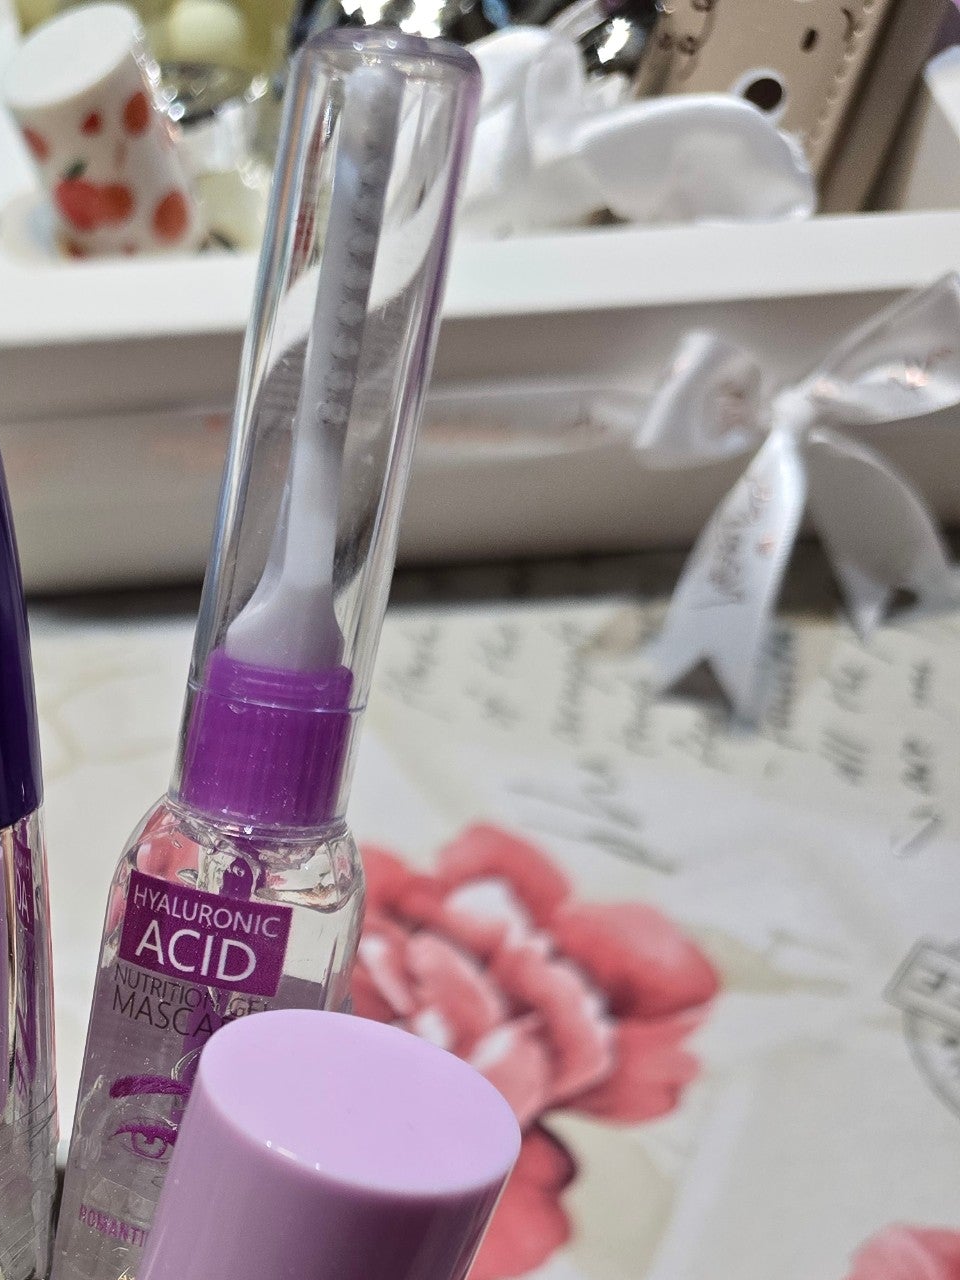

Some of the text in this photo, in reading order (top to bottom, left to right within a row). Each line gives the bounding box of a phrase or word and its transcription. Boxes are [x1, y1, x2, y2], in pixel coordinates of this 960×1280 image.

[133, 884, 281, 938] HYALURONIC
[135, 919, 257, 982] ACID
[112, 985, 237, 1038] MASCA
